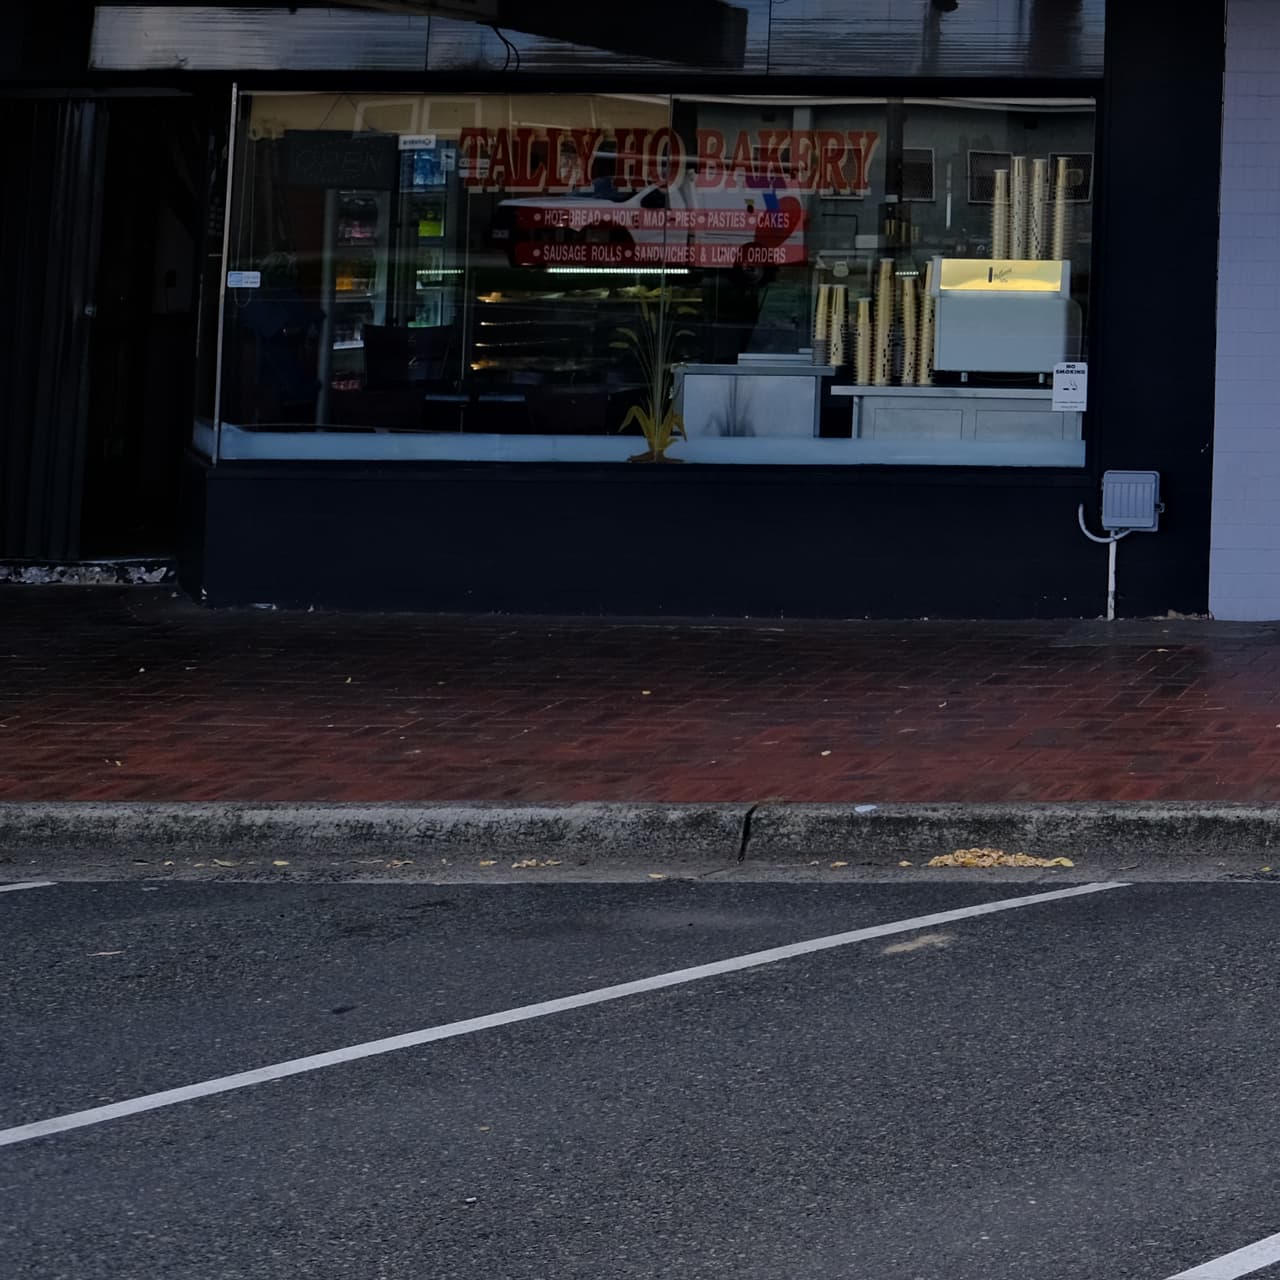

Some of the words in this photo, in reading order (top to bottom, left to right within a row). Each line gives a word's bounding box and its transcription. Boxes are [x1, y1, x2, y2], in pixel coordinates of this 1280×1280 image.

[459, 127, 604, 193] TALLY
[614, 127, 686, 193] HO
[695, 129, 880, 195] BAKERY
[544, 210, 565, 226] HOT
[569, 210, 600, 226] BREAD
[612, 211, 639, 226] HOME
[674, 211, 696, 227] PIES
[708, 211, 745, 228] PASTIES
[757, 211, 790, 228] CAKES
[543, 245, 587, 262] SAUSAGE
[591, 245, 623, 262] ROLLS
[632, 246, 696, 263] SANDWICHES
[711, 247, 742, 263] LUNCH
[747, 247, 787, 264] ORDERS
